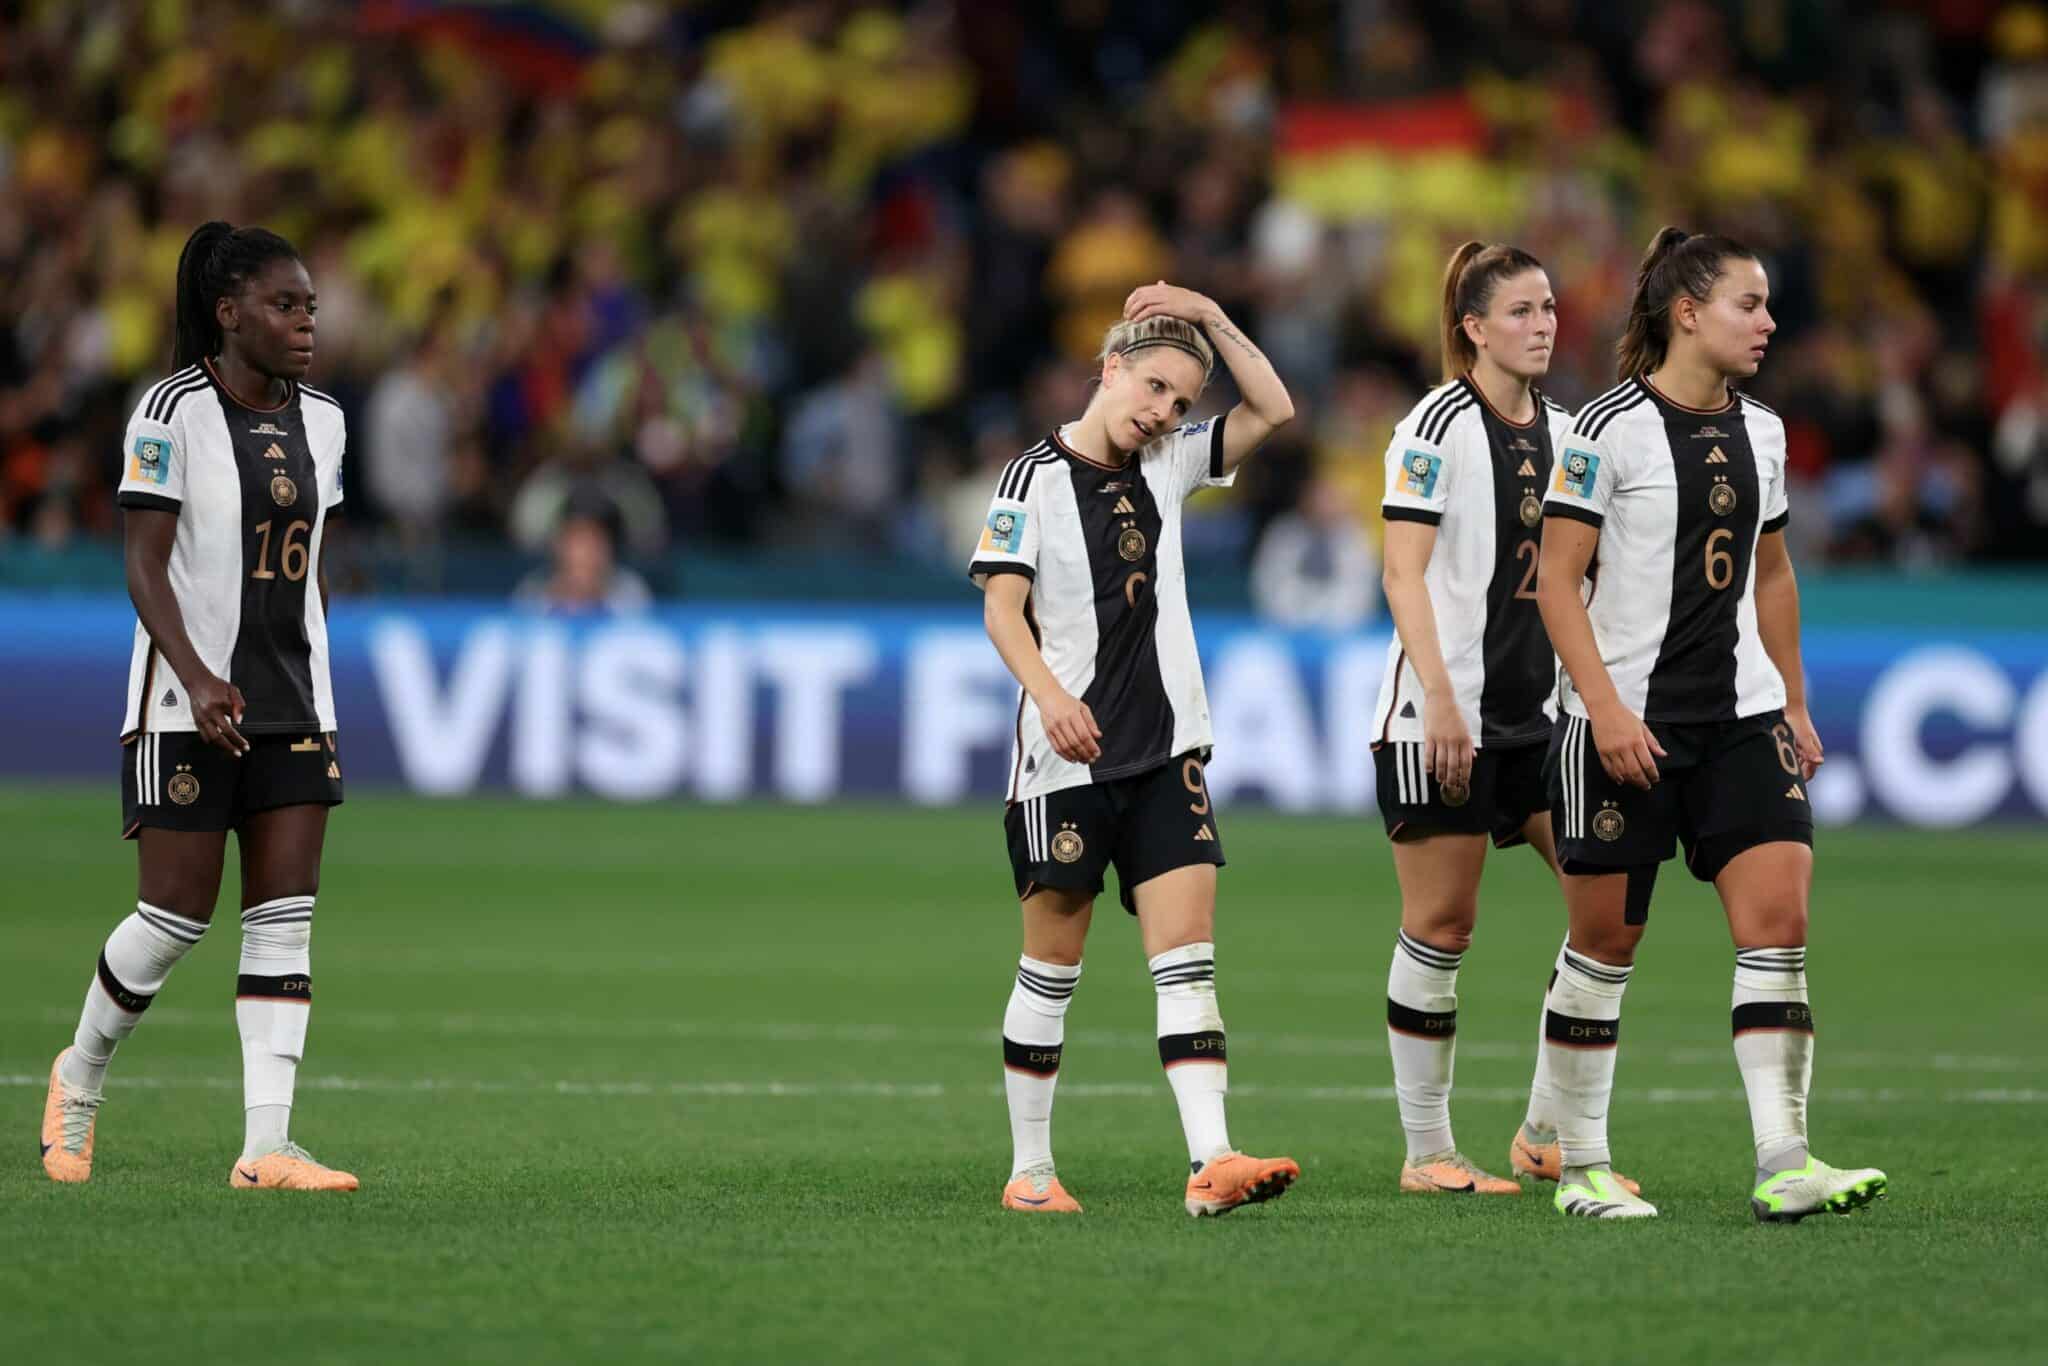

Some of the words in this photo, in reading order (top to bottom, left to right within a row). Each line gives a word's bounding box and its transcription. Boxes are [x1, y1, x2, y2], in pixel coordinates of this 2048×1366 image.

[251, 520, 310, 580] 16
[1514, 539, 1538, 600] 2
[1705, 528, 1734, 590] 6
[370, 617, 876, 803] VISIT
[1772, 723, 1799, 775] 6
[1183, 758, 1209, 814] 9
[1568, 1025, 1612, 1038] DFB
